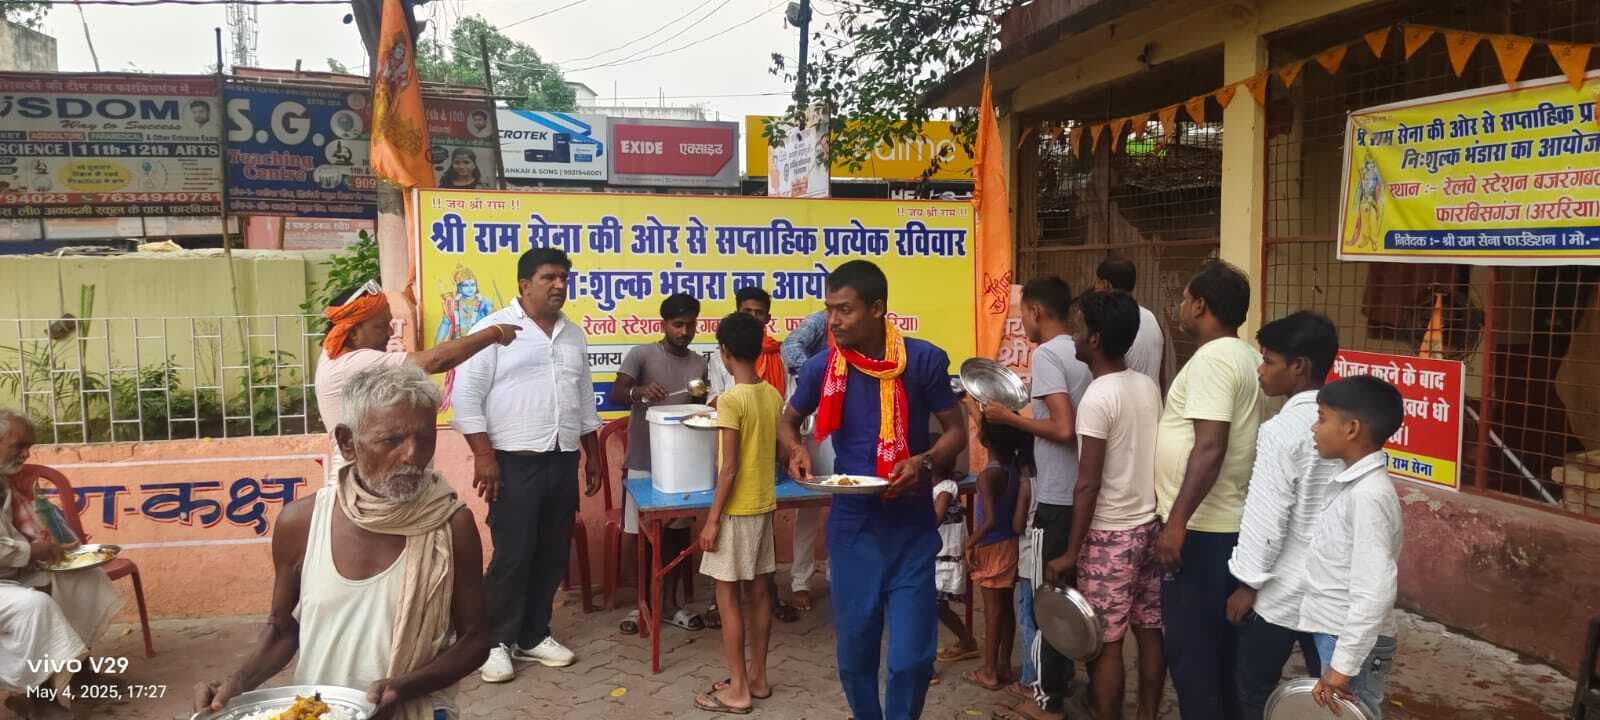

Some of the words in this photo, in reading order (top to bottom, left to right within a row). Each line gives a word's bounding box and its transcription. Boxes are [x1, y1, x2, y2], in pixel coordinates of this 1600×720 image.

[60, 120, 97, 130] Way
[102, 122, 118, 130] to
[124, 120, 182, 130] Success
[227, 98, 325, 146] S.G.
[1397, 121, 1424, 144] सेना
[1427, 118, 1445, 141] की
[1450, 114, 1478, 138] ओर
[1481, 110, 1495, 133] से
[1501, 102, 1574, 131] सप्ताहिक
[0, 144, 64, 157] SCIENCE
[77, 145, 169, 156] 11th-12th
[175, 145, 219, 157] ARTS
[620, 140, 663, 155] EXIDE
[679, 143, 724, 155] एक्साइड
[1465, 140, 1507, 165] भंडारा
[1511, 139, 1534, 159] का
[225, 148, 314, 171] Teaching
[242, 164, 306, 180] Centre
[1388, 182, 1422, 198] स्थान
[1443, 176, 1476, 197] रेलवे
[1482, 173, 1528, 194] स्टेशन
[99, 193, 220, 204] 7634940781
[446, 200, 465, 210] जय
[469, 198, 482, 210] श्री
[487, 200, 505, 210] राम
[128, 204, 140, 216] के
[908, 208, 923, 217] जय
[926, 205, 938, 217] श्री
[940, 207, 956, 217] राम
[1436, 201, 1522, 223] फारबिसगंज
[430, 213, 466, 253] श्री
[474, 223, 521, 253] राम
[528, 214, 582, 253] सेना
[588, 215, 623, 254] की
[632, 215, 680, 254] ओर
[687, 216, 709, 255] से
[715, 218, 818, 256] सप्ताहिक
[823, 219, 890, 257] प्रत्येक
[895, 220, 968, 257] रविवार
[1394, 233, 1427, 247] निवेदक
[1442, 233, 1457, 248] श्री
[1458, 235, 1476, 247] राम
[1478, 232, 1500, 247] सेना
[1503, 231, 1556, 247] फाउंडेशन
[660, 260, 728, 300] भंडारा
[772, 263, 832, 300] आयो
[583, 315, 617, 335] रेलवे
[622, 314, 665, 335] स्टेशन
[588, 352, 622, 366] समय
[1333, 355, 1369, 379] भोजन
[1371, 361, 1400, 385] करने
[1402, 362, 1417, 387] के
[1432, 397, 1450, 423] धो
[1391, 456, 1409, 472] राम
[1411, 457, 1433, 477] सेना
